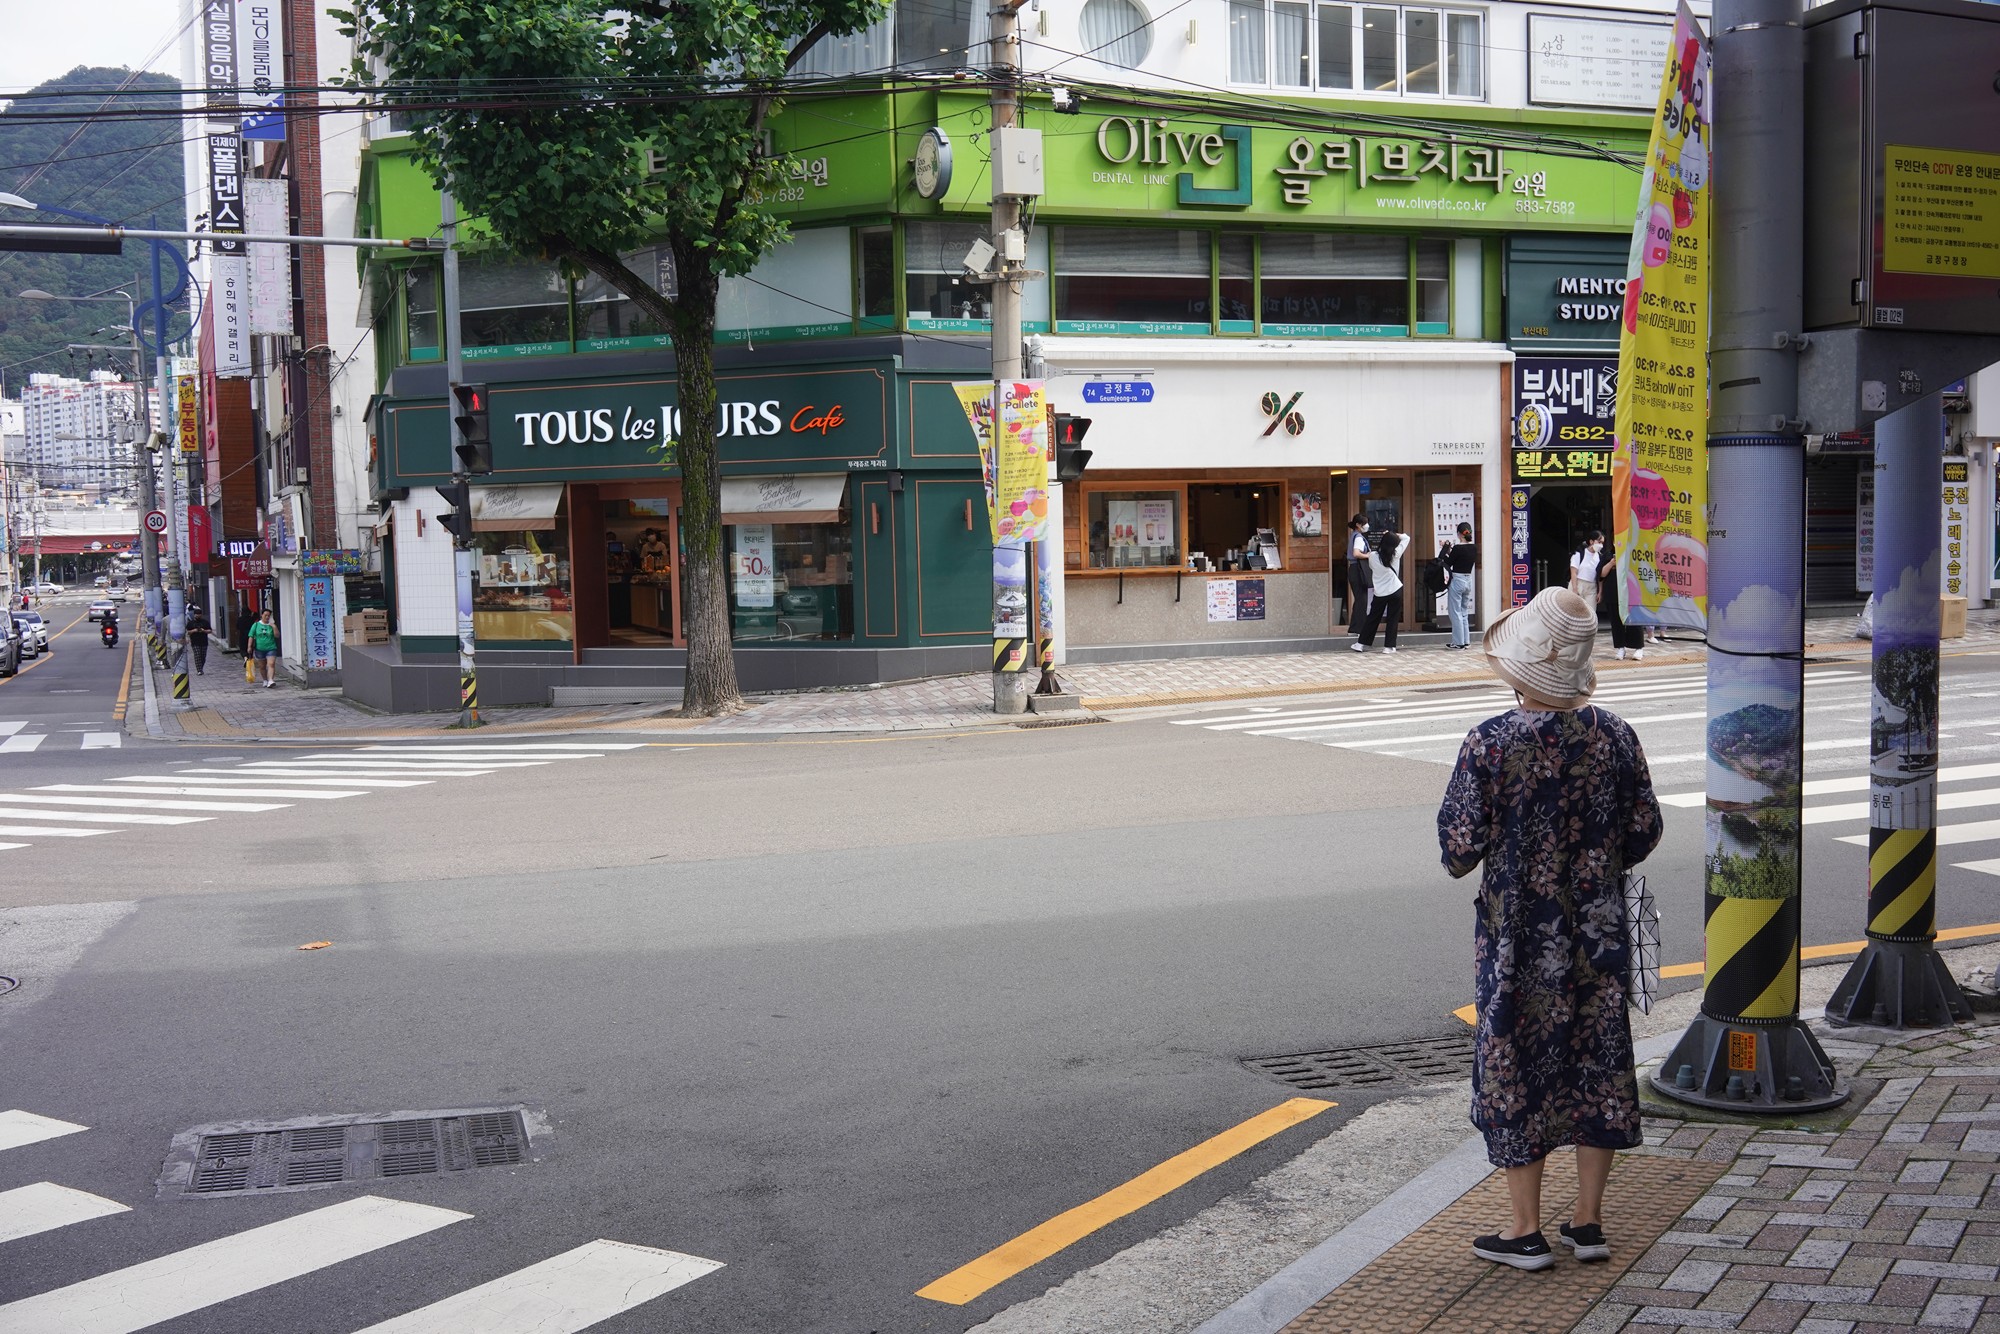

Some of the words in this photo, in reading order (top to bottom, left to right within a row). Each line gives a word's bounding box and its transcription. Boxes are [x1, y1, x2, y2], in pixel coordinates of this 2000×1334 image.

[207, 2, 234, 83] 실용음악
[252, 7, 270, 76] 모닝글로리
[210, 136, 238, 148] 더제이
[1097, 115, 1224, 166] Olive
[1274, 134, 1513, 205] 올리브치과
[1512, 171, 1547, 197] 의원
[1895, 159, 1930, 174] 무인단속
[1933, 163, 1954, 176] CCTV
[1956, 164, 1973, 178] 운영
[212, 147, 240, 227] 폴댄스
[1092, 171, 1134, 184] DENTAL
[1143, 174, 1170, 186] LINIC
[1376, 197, 1487, 212] www.olivedc.co.kr
[1515, 200, 1575, 215] 583-7582
[225, 277, 240, 363] 승희헤어갤러리
[1560, 303, 1620, 321] STUDY
[1522, 326, 1549, 336] 부산대점
[1005, 391, 1039, 400] Culture
[1104, 383, 1132, 394] 금정로
[1141, 388, 1150, 396] 70
[1521, 368, 1593, 416] 부산대
[1005, 400, 1039, 410] Pallete
[181, 402, 197, 449] 부동산
[515, 408, 613, 446] TOUS
[621, 406, 655, 441] les
[660, 400, 782, 448] JURS
[789, 404, 846, 436] Café
[1943, 487, 1968, 504] 동전
[149, 516, 163, 527] 30
[1512, 510, 1529, 559] 김사부
[1947, 508, 1962, 594] 노래연습장
[311, 597, 328, 657] 노래연습장
[315, 658, 328, 668] 3F
